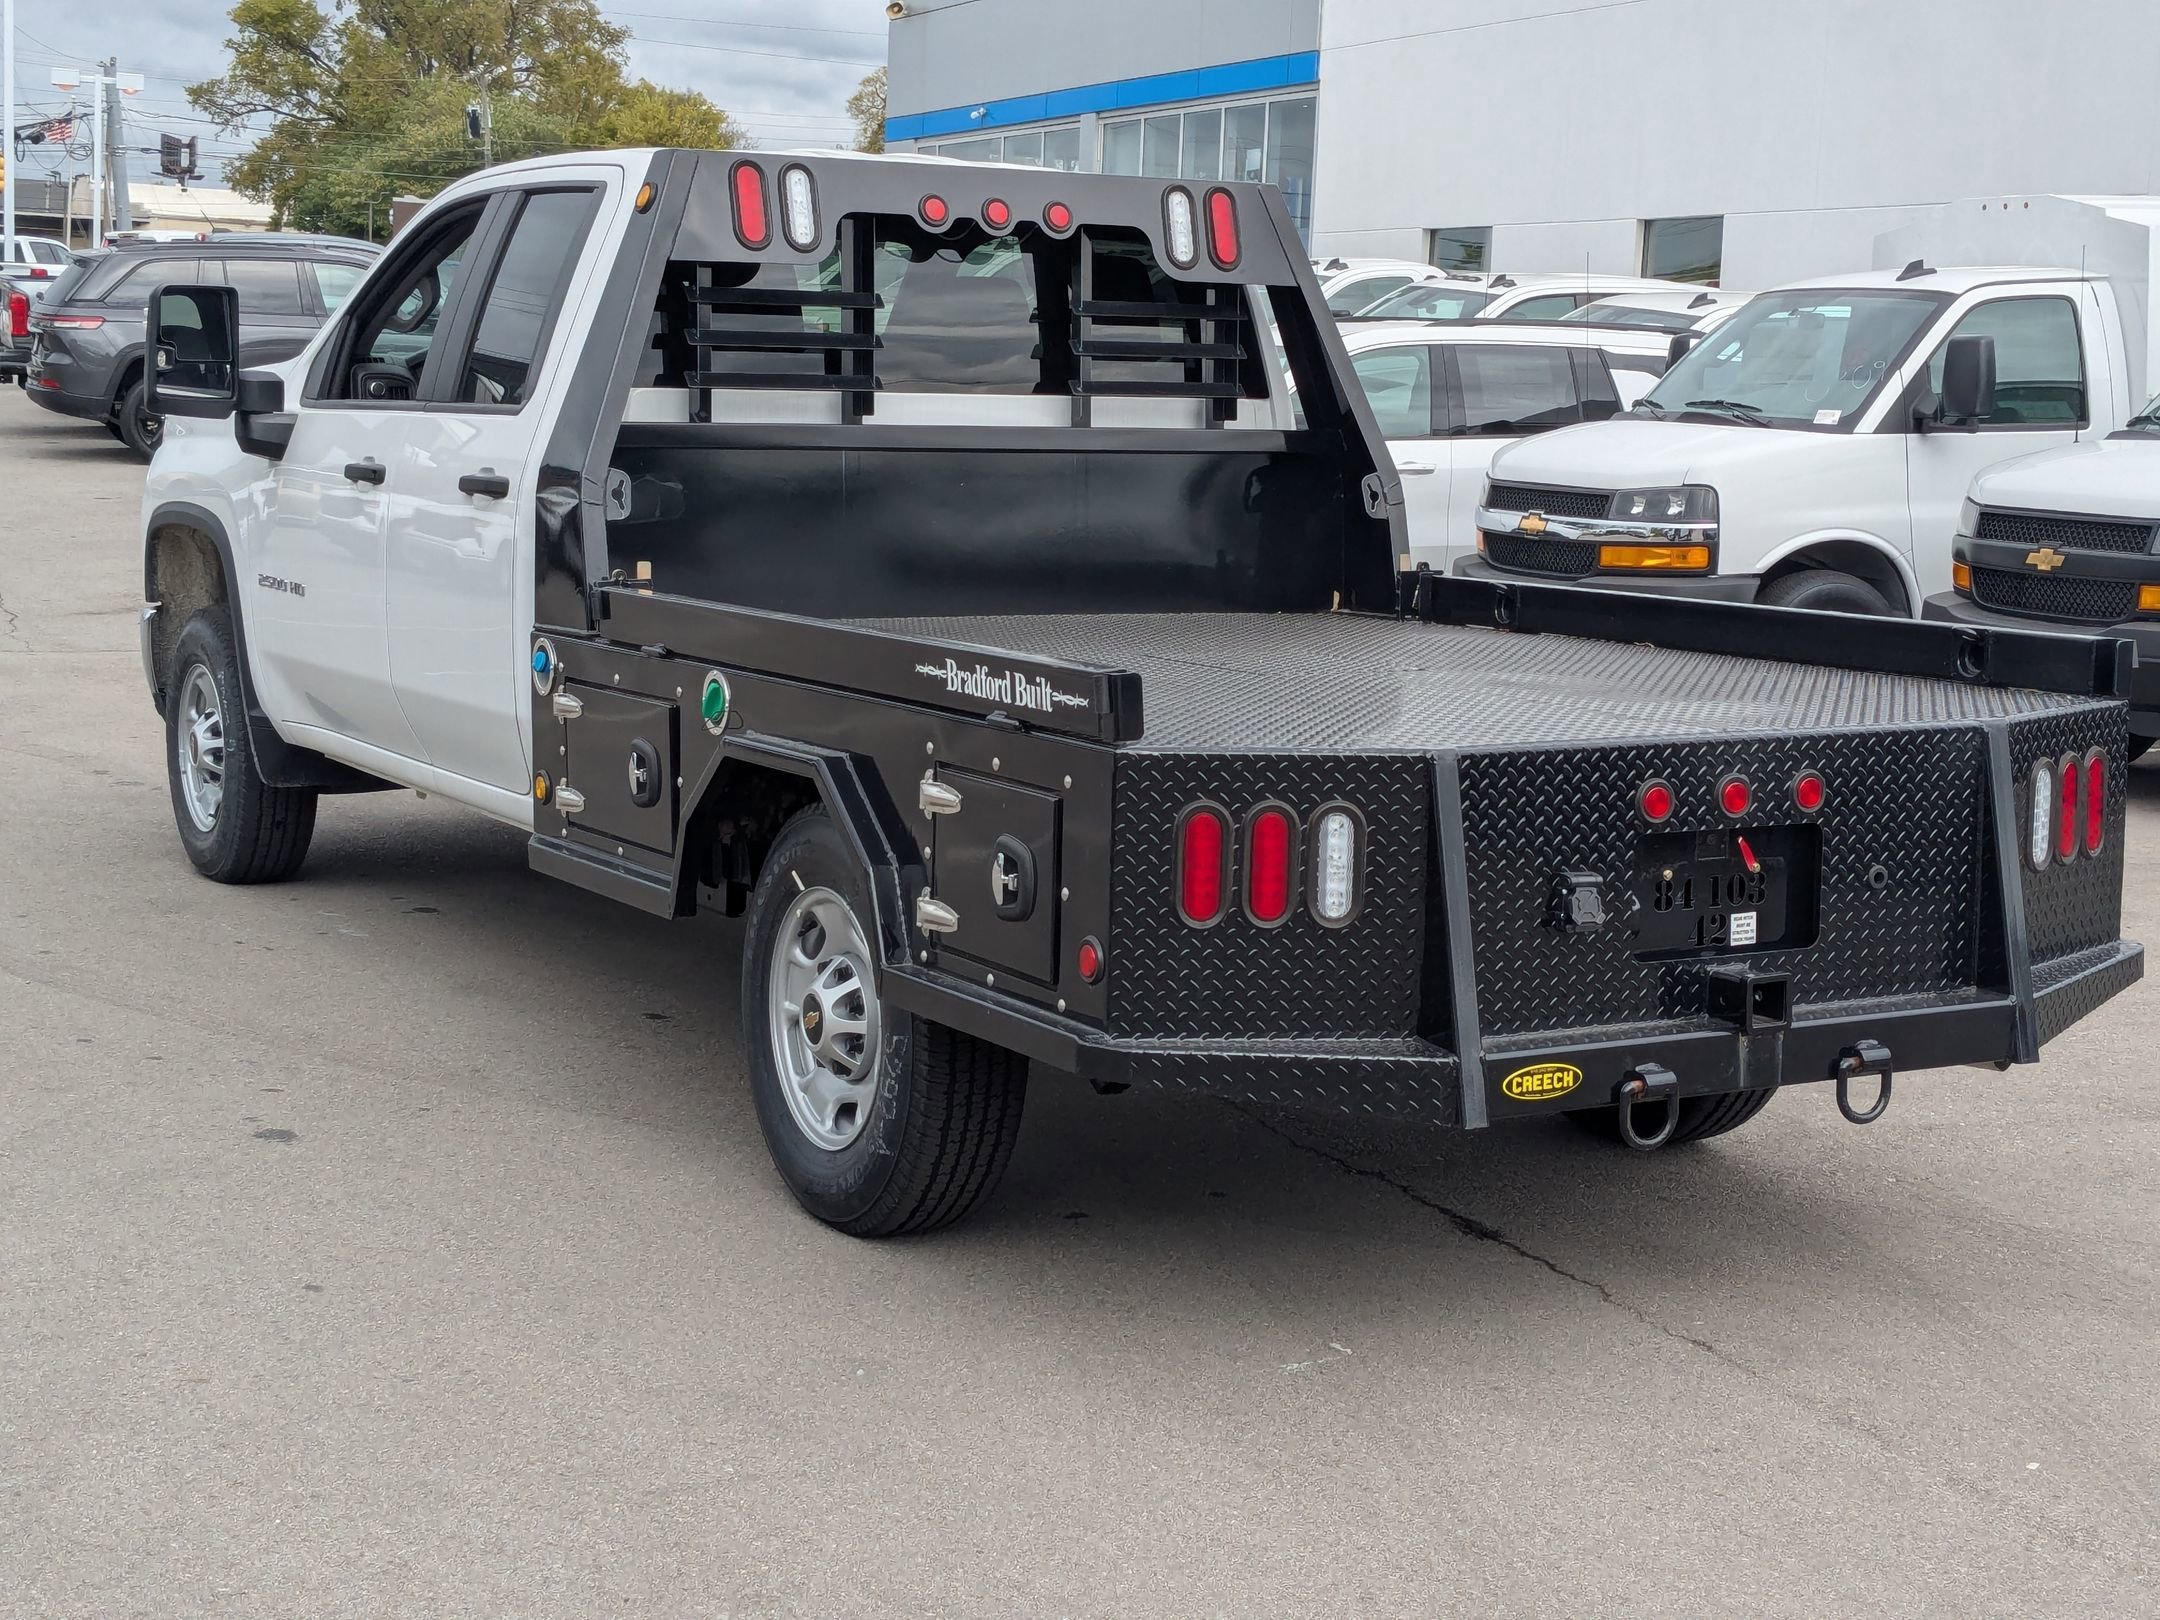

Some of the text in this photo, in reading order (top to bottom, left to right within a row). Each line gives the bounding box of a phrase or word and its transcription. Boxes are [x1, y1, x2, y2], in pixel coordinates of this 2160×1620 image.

[944, 658, 1053, 712] Bradford Built
[1654, 873, 1766, 912] 84 103
[1688, 913, 1729, 947] 42
[1512, 1070, 1574, 1094] CREECH
